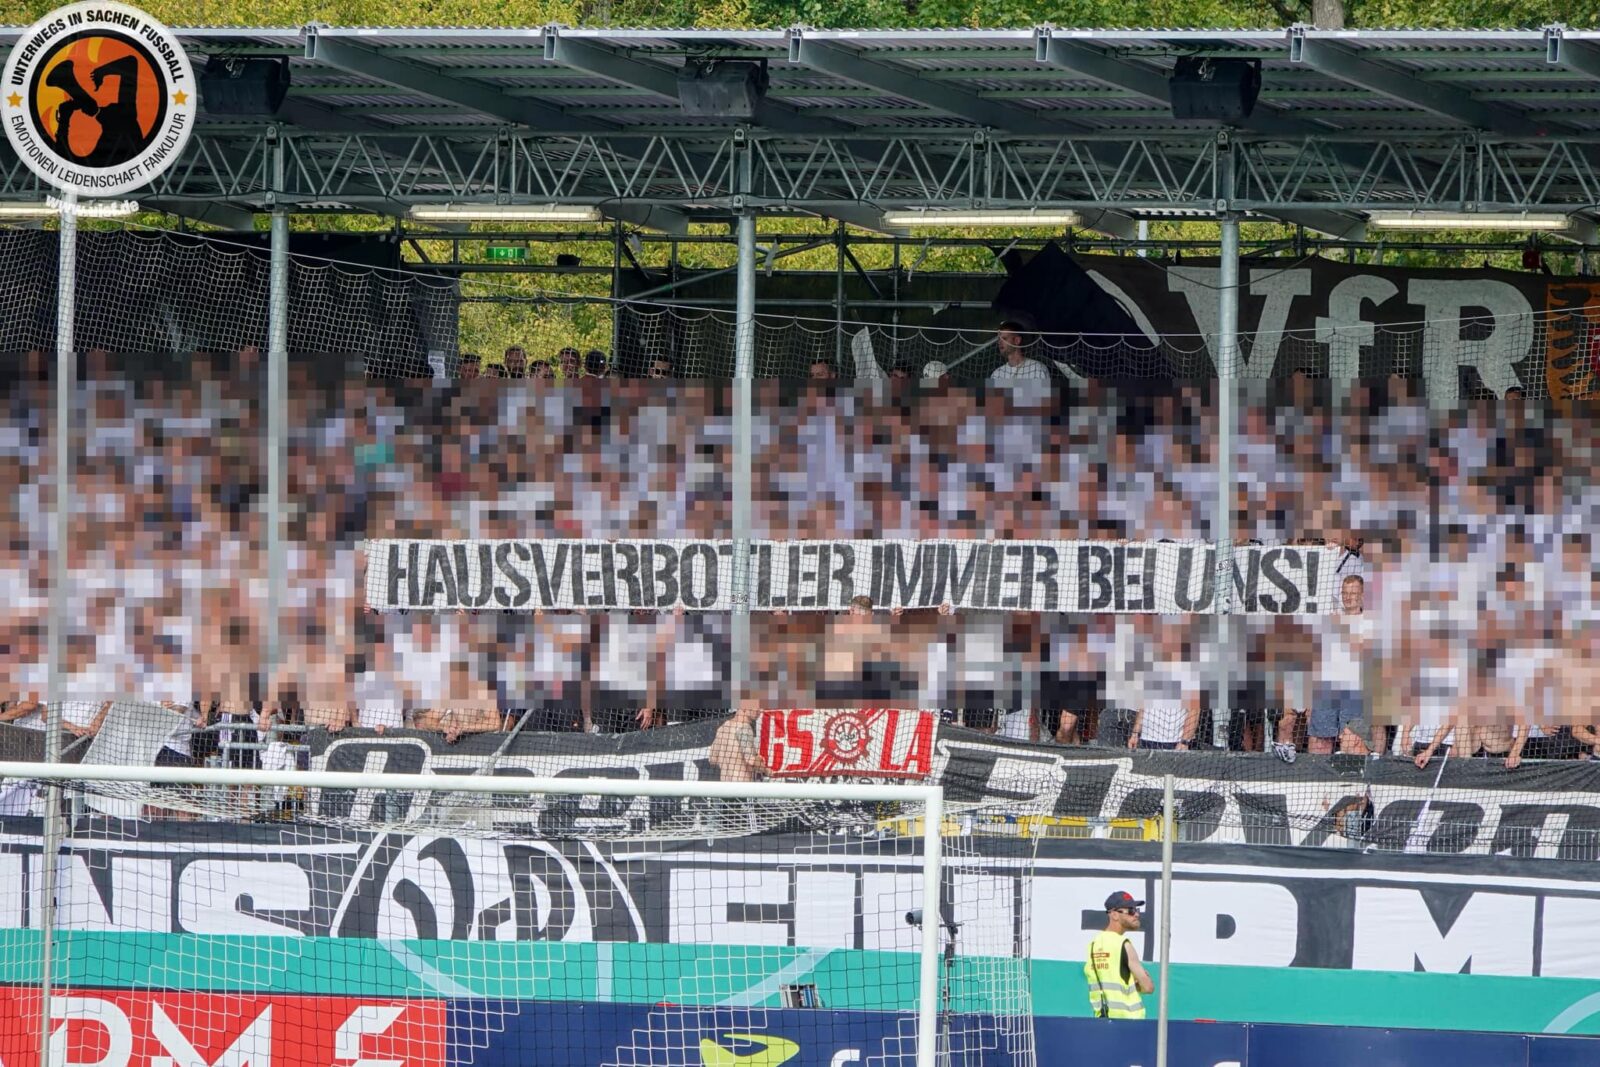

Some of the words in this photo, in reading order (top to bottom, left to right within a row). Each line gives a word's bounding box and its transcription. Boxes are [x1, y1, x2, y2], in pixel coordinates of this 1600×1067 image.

[1167, 266, 1534, 407] VfR
[386, 542, 857, 608] HAUSVERBOLER
[869, 543, 1059, 609] IMMER
[1077, 544, 1158, 611] BEI
[1174, 547, 1320, 614] UNS!
